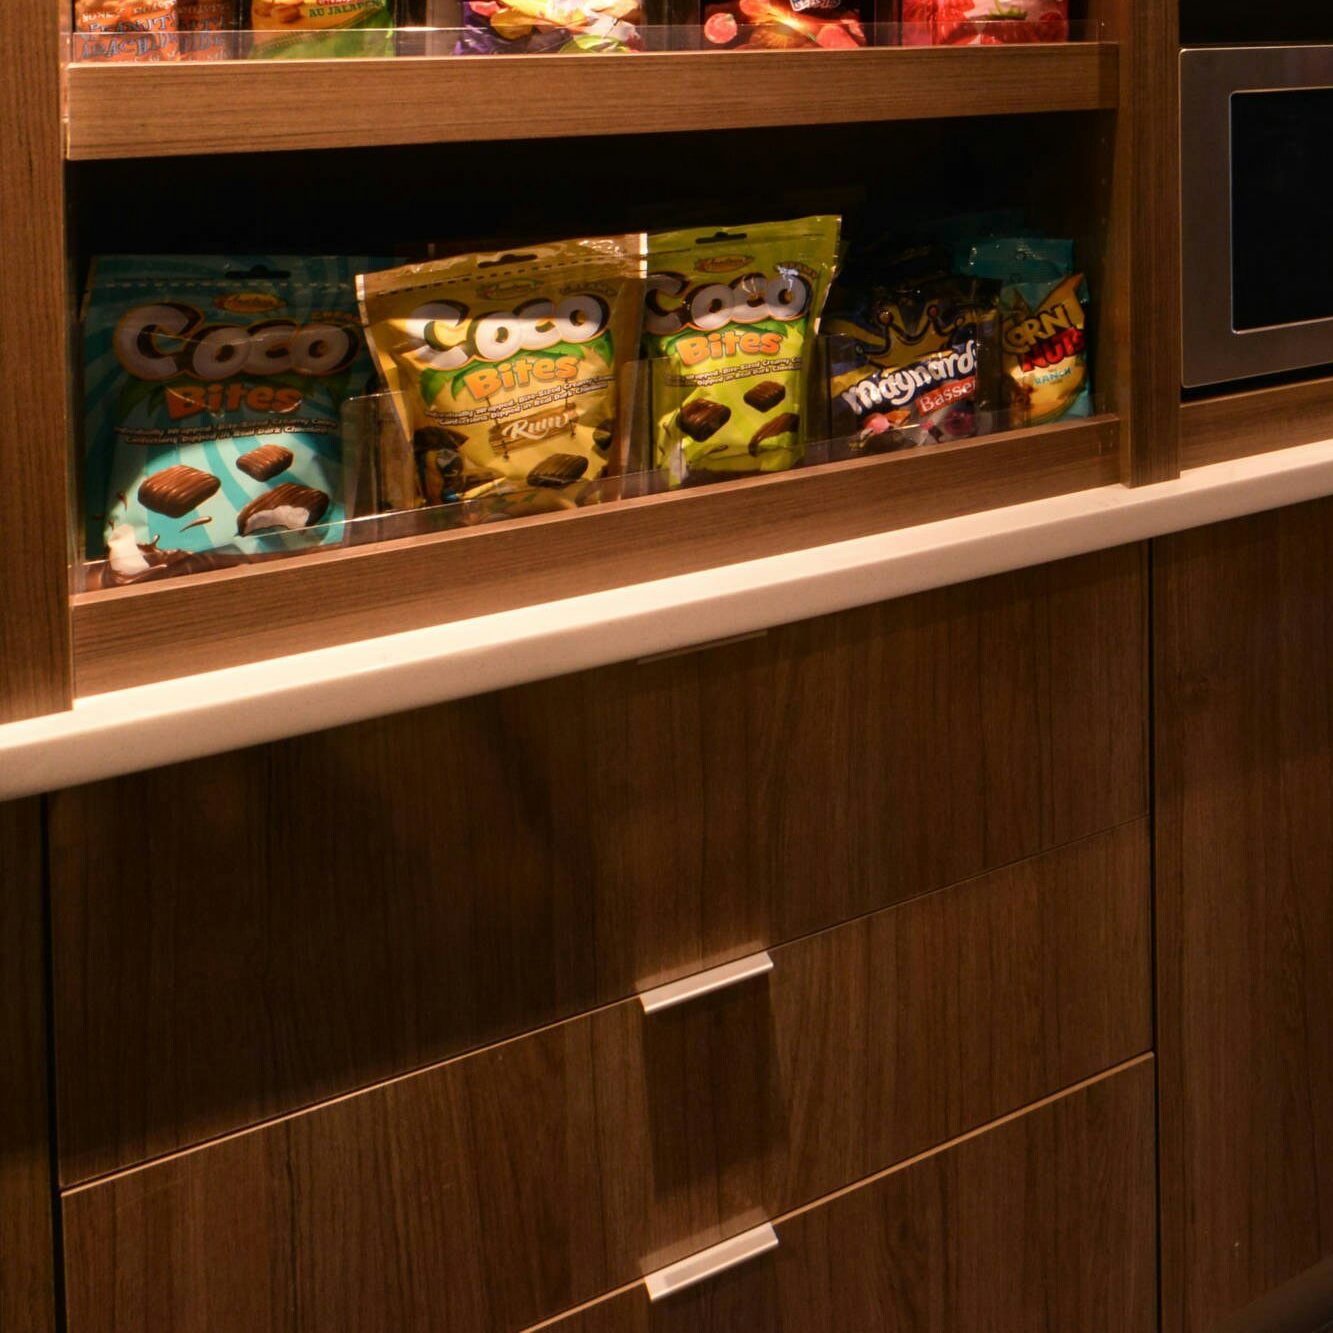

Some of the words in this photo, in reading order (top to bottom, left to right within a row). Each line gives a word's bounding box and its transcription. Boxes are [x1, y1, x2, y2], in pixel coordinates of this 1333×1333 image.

[308, 6, 325, 18] AU
[676, 330, 783, 367] Bites
[464, 355, 581, 401] Bites
[919, 377, 977, 414] Basse
[1034, 368, 1073, 386] RANCH
[165, 383, 305, 420] Bites
[503, 411, 570, 441] Rum
